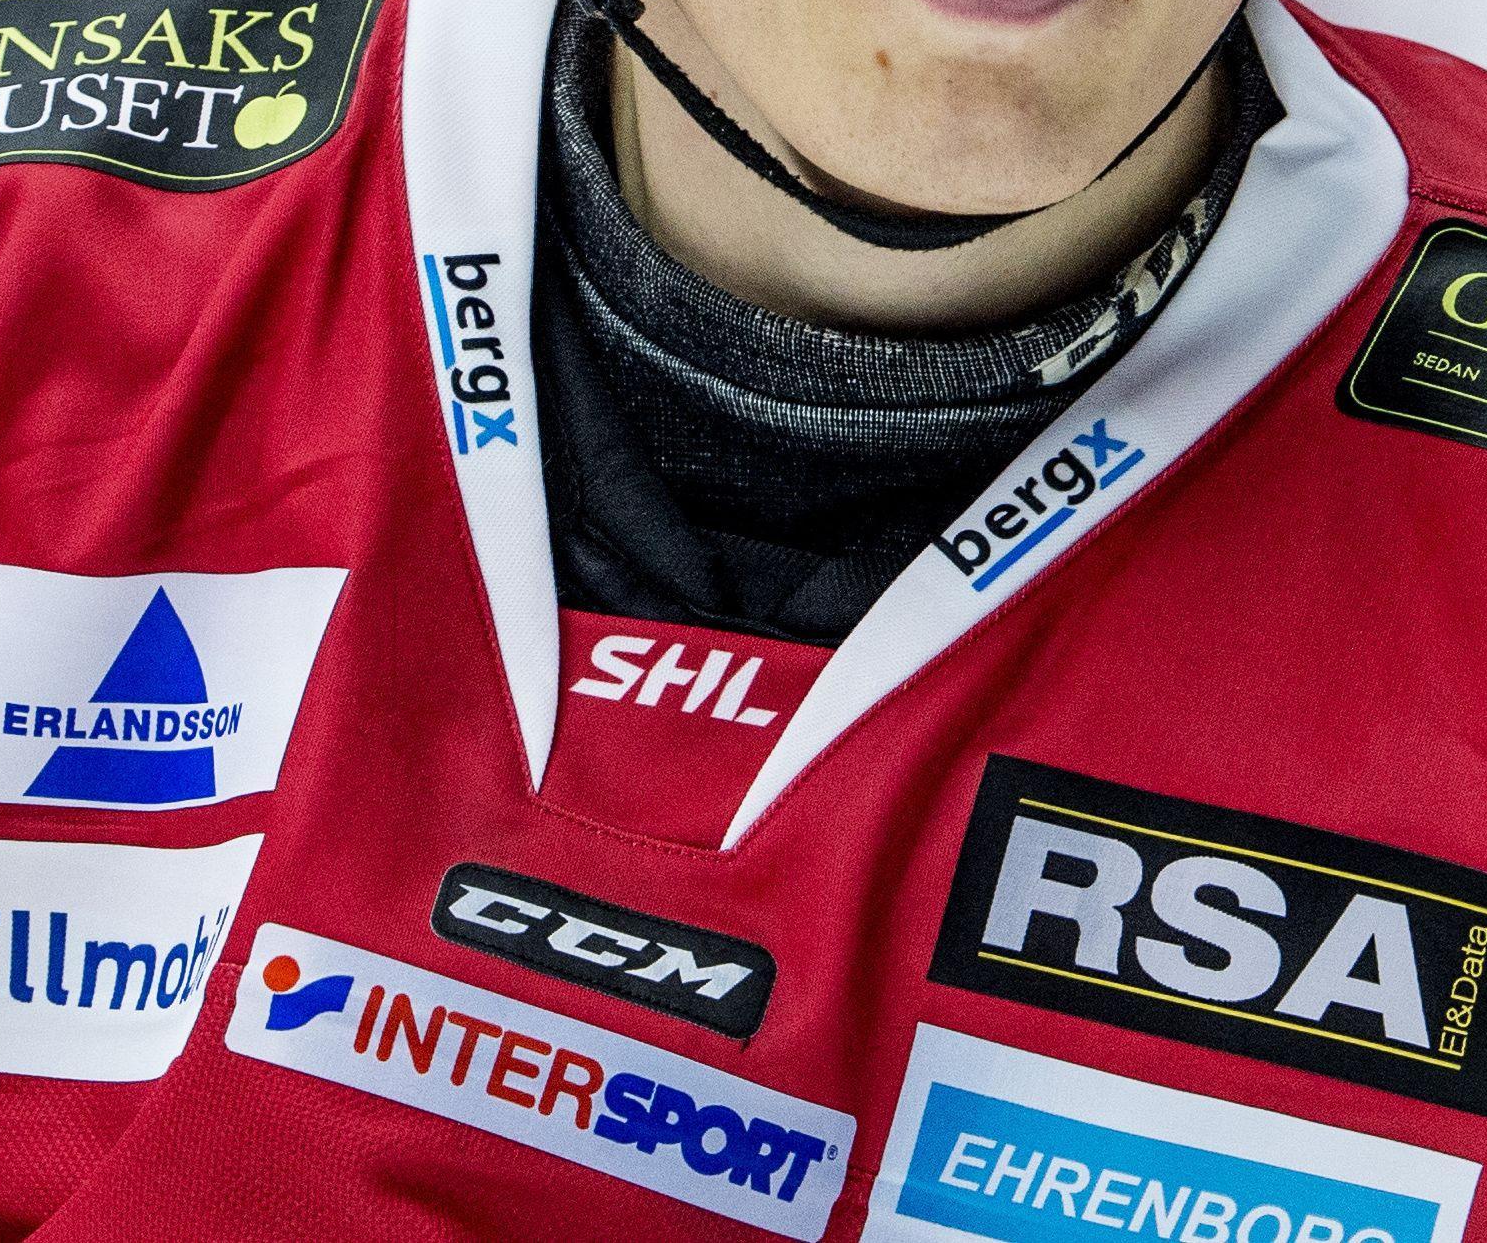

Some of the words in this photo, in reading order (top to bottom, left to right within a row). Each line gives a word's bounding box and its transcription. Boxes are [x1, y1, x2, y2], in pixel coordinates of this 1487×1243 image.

[443, 253, 518, 448] bergx
[1412, 350, 1481, 382] SEDAN
[932, 418, 1129, 577] bergx
[3, 701, 243, 743] ERLANDSSON
[569, 634, 780, 727] SHL
[448, 883, 754, 1002] CCM
[981, 815, 1432, 1050] RSA
[352, 984, 827, 1204] INTERSPORT
[938, 1132, 1395, 1243] EHRENBOR
